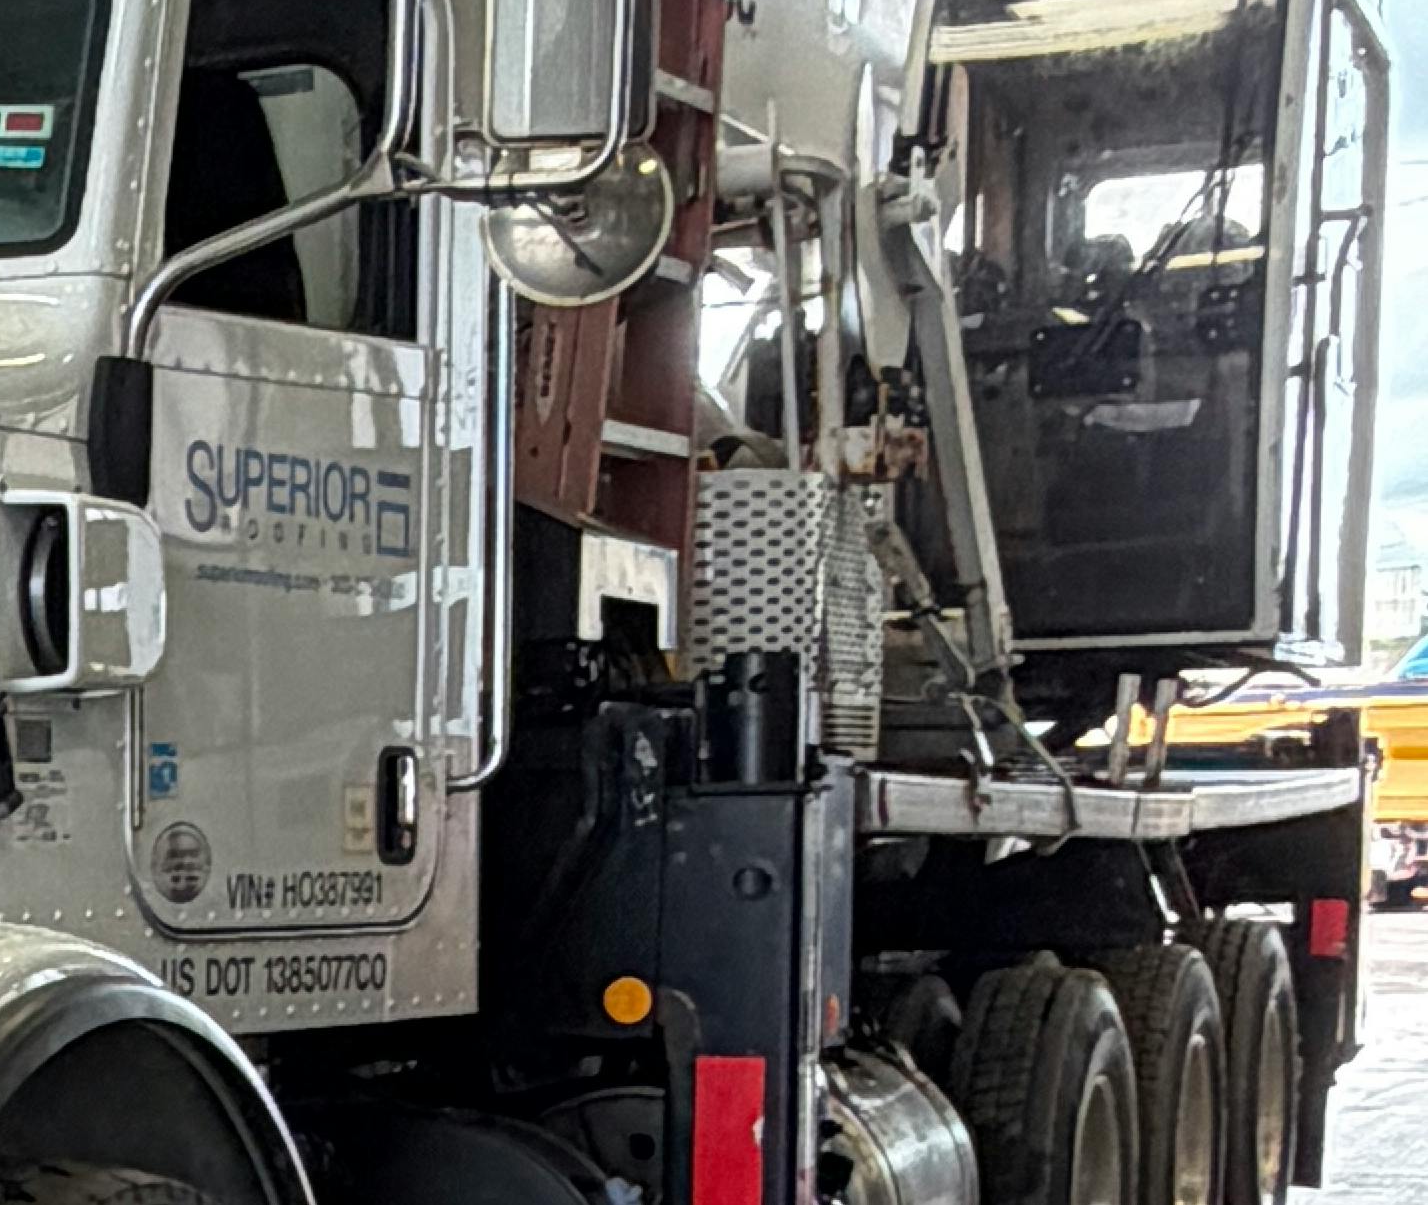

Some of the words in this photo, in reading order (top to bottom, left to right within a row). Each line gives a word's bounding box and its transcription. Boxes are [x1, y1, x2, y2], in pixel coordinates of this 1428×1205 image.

[185, 440, 371, 533] SUPERIOR
[226, 873, 276, 910] VIN#
[205, 955, 256, 996] DOT
